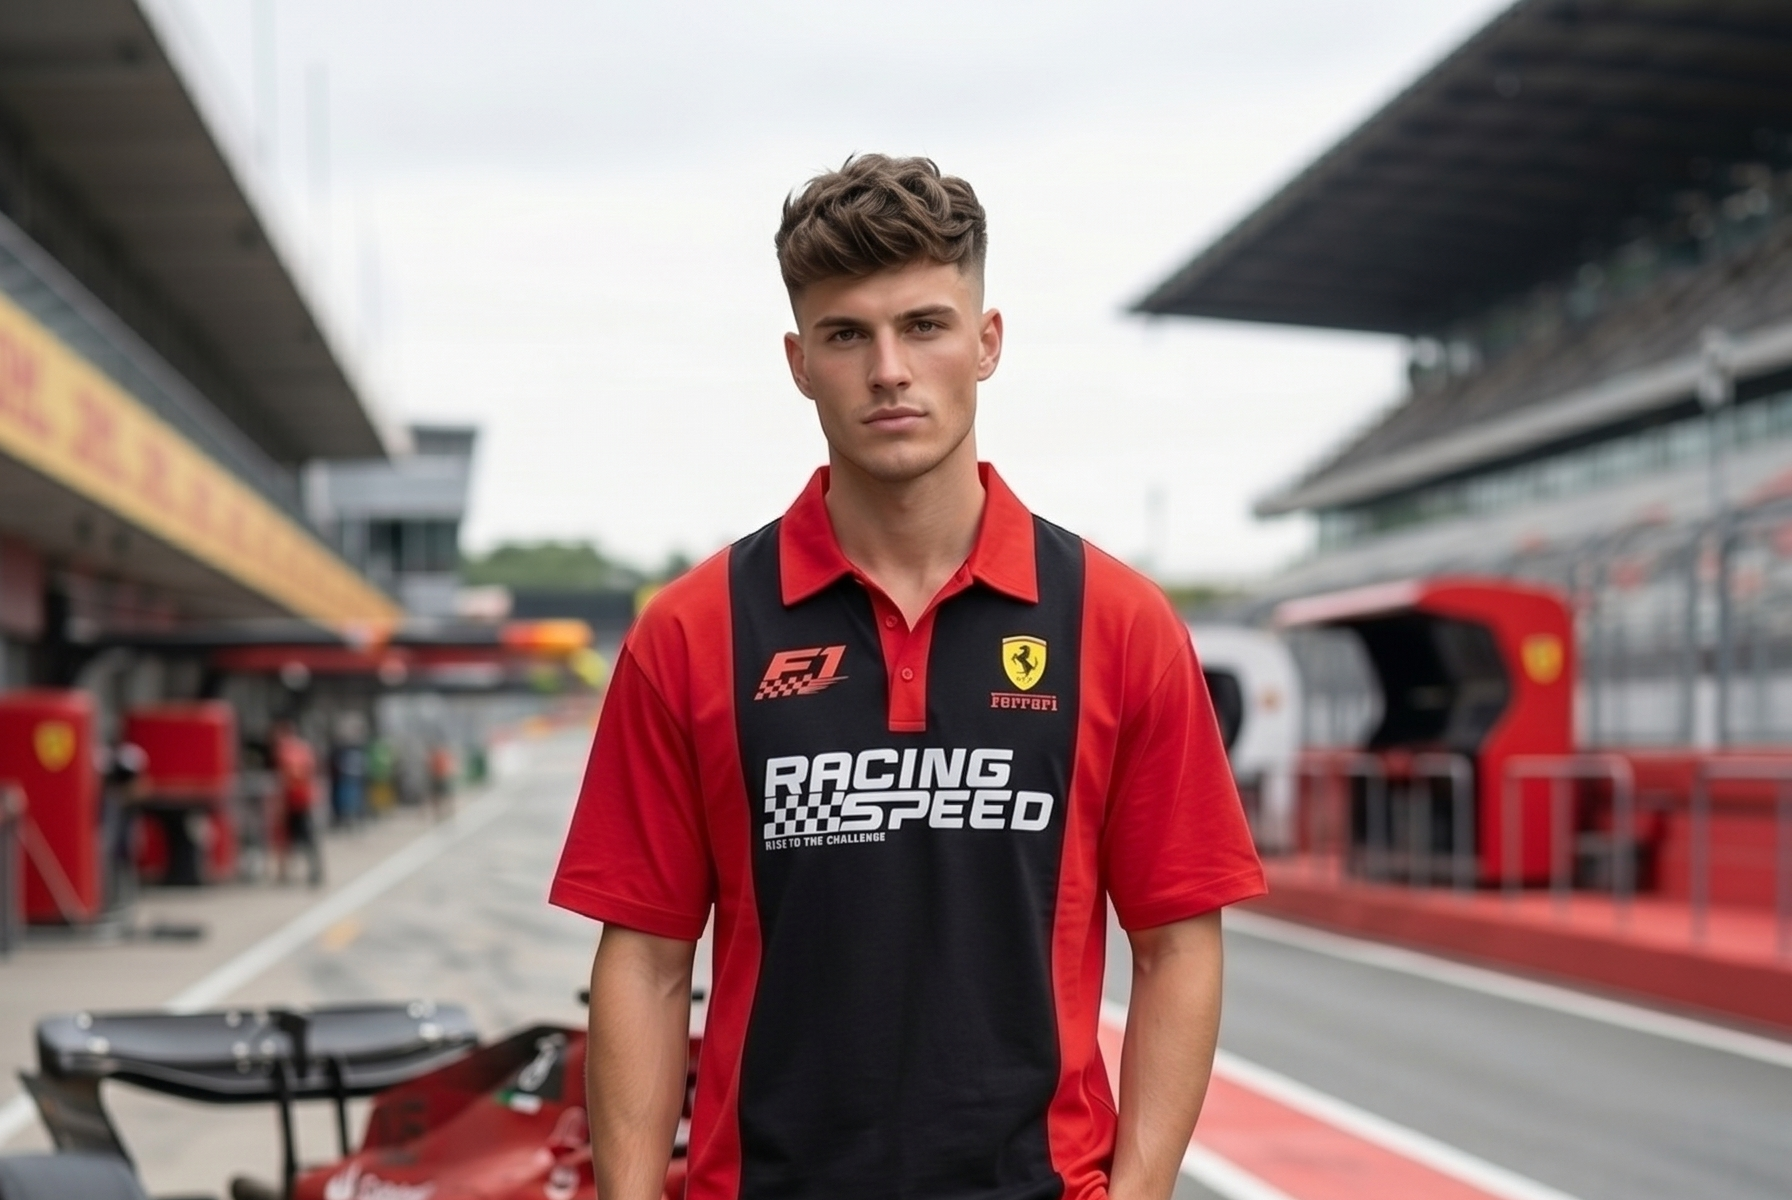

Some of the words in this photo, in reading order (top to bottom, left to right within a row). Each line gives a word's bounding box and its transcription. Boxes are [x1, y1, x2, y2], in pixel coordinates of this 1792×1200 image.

[763, 645, 847, 680] F1
[990, 692, 1058, 711] Ferrari
[764, 748, 1014, 798] RACING
[839, 790, 1055, 832] SPEED
[765, 838, 788, 851] RISE
[788, 837, 801, 848] TO
[803, 835, 824, 847] THE
[826, 831, 886, 846] CHALLENGE
